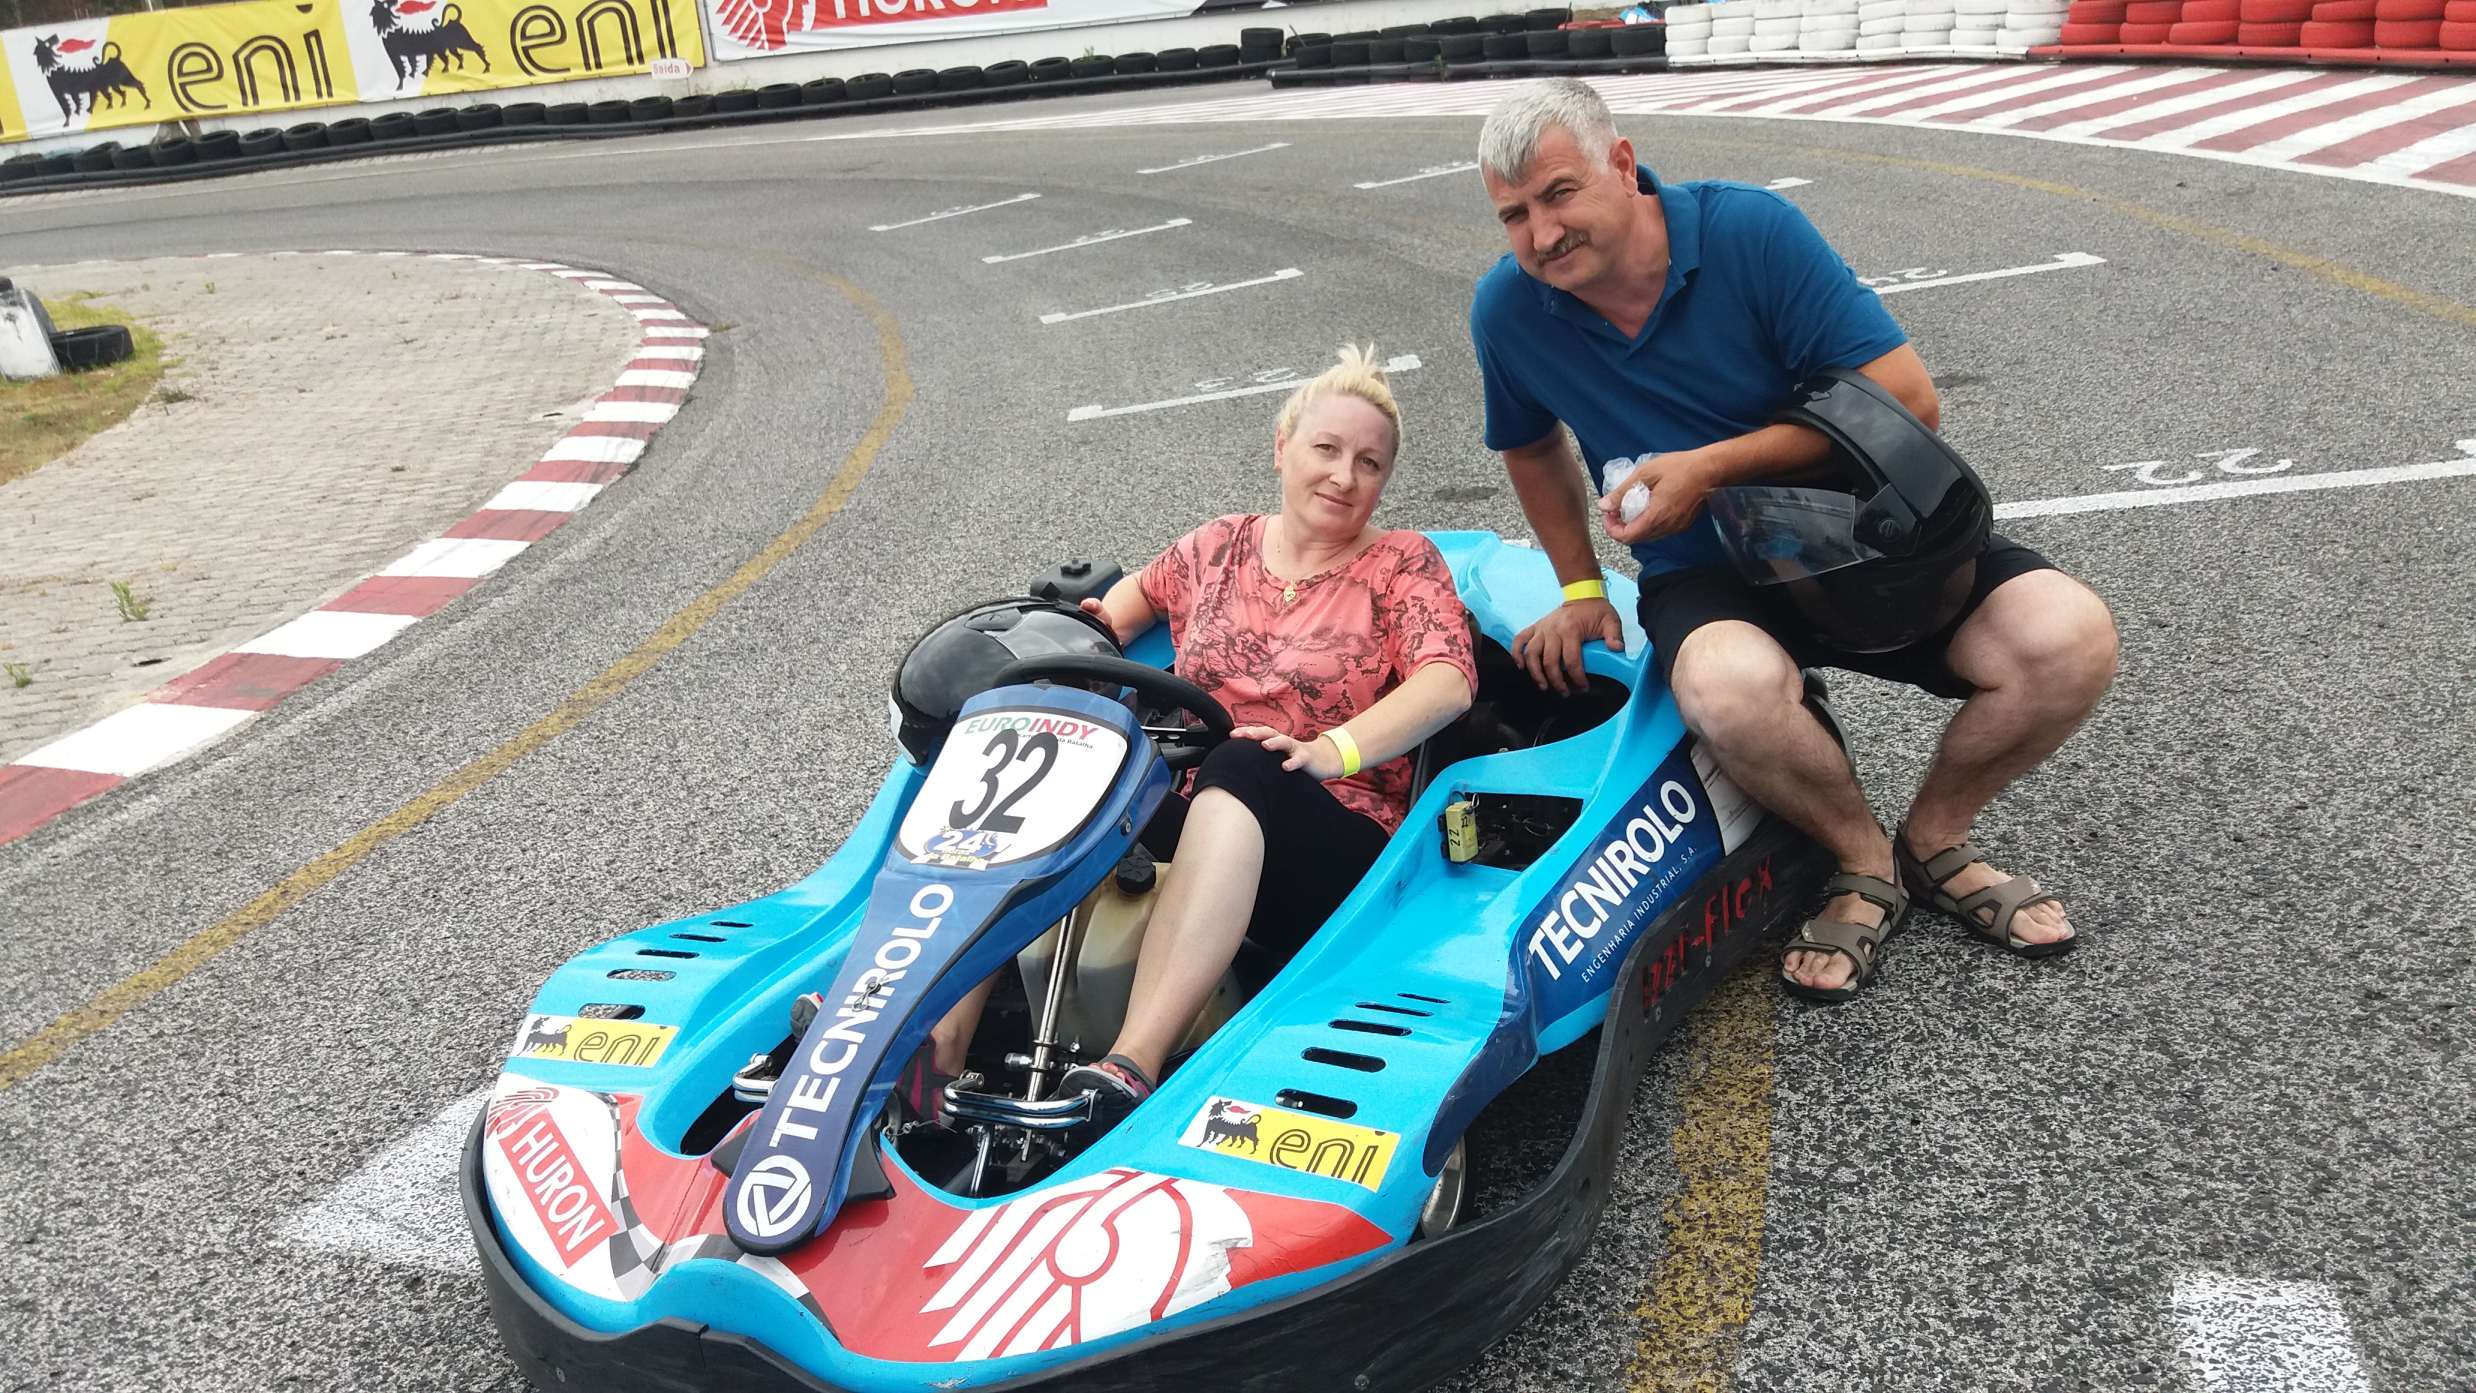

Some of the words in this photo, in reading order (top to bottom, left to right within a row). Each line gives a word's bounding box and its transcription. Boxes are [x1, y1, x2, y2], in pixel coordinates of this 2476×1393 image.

[168, 4, 334, 112] eni
[509, 0, 678, 76] eni
[2100, 447, 2294, 485] 22
[948, 728, 1059, 834] 32
[964, 717, 1100, 740] EUROINDY
[1528, 780, 1697, 982] TECNIROLO
[1581, 919, 1636, 983] ENGENHARIA
[1633, 865, 1682, 921] INDUSTRIAL,
[573, 1025, 667, 1066] eni
[769, 884, 955, 1148] TECNIROLO
[511, 1120, 605, 1252] HURON
[1268, 1130, 1387, 1185] eni
